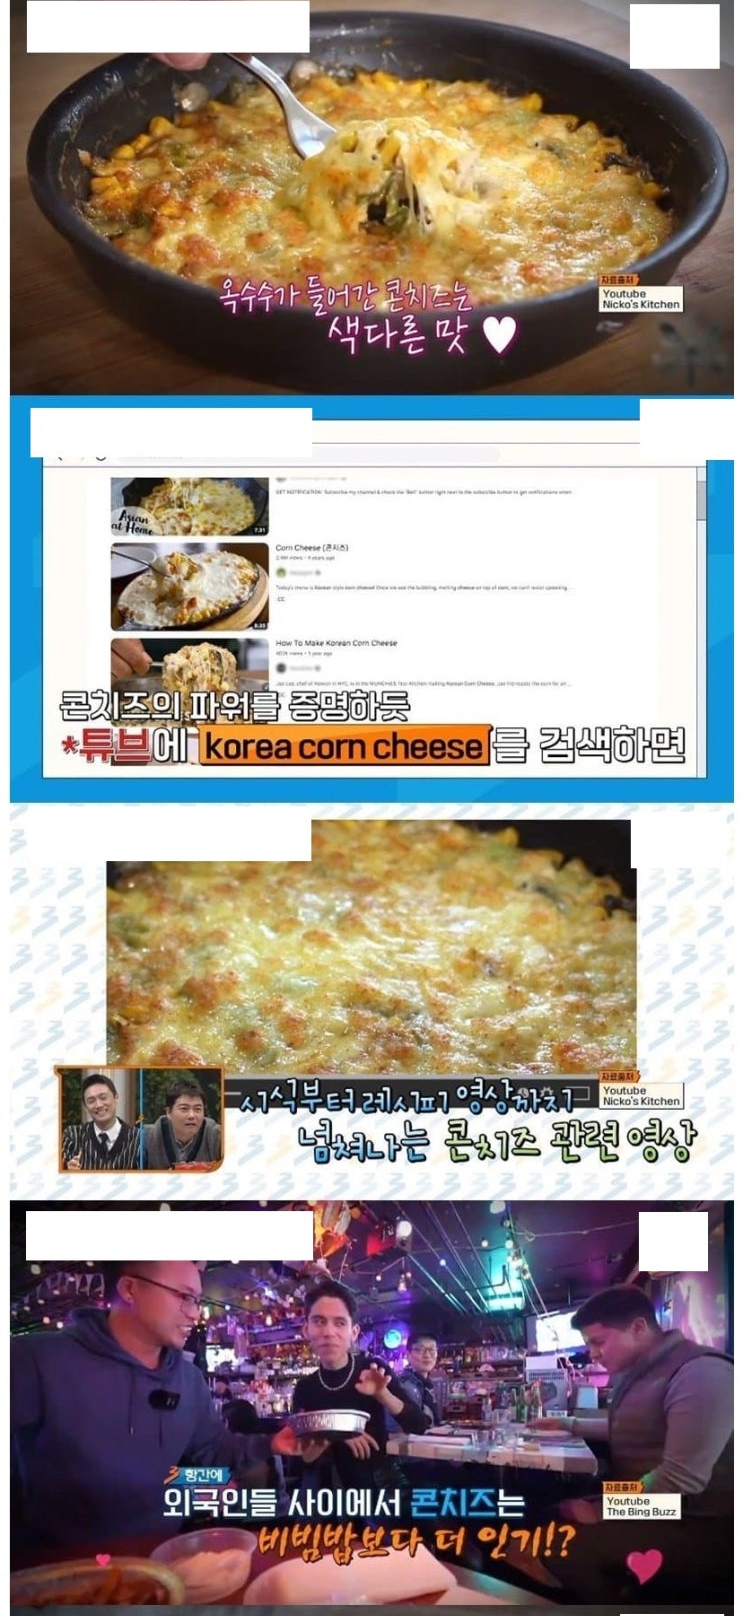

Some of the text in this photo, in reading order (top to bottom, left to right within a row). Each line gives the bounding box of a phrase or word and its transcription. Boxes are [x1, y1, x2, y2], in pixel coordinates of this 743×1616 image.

[275, 543, 293, 552] Corn
[294, 543, 321, 552] Cheese
[275, 639, 398, 647] How To Make Korean Corn Cheese
